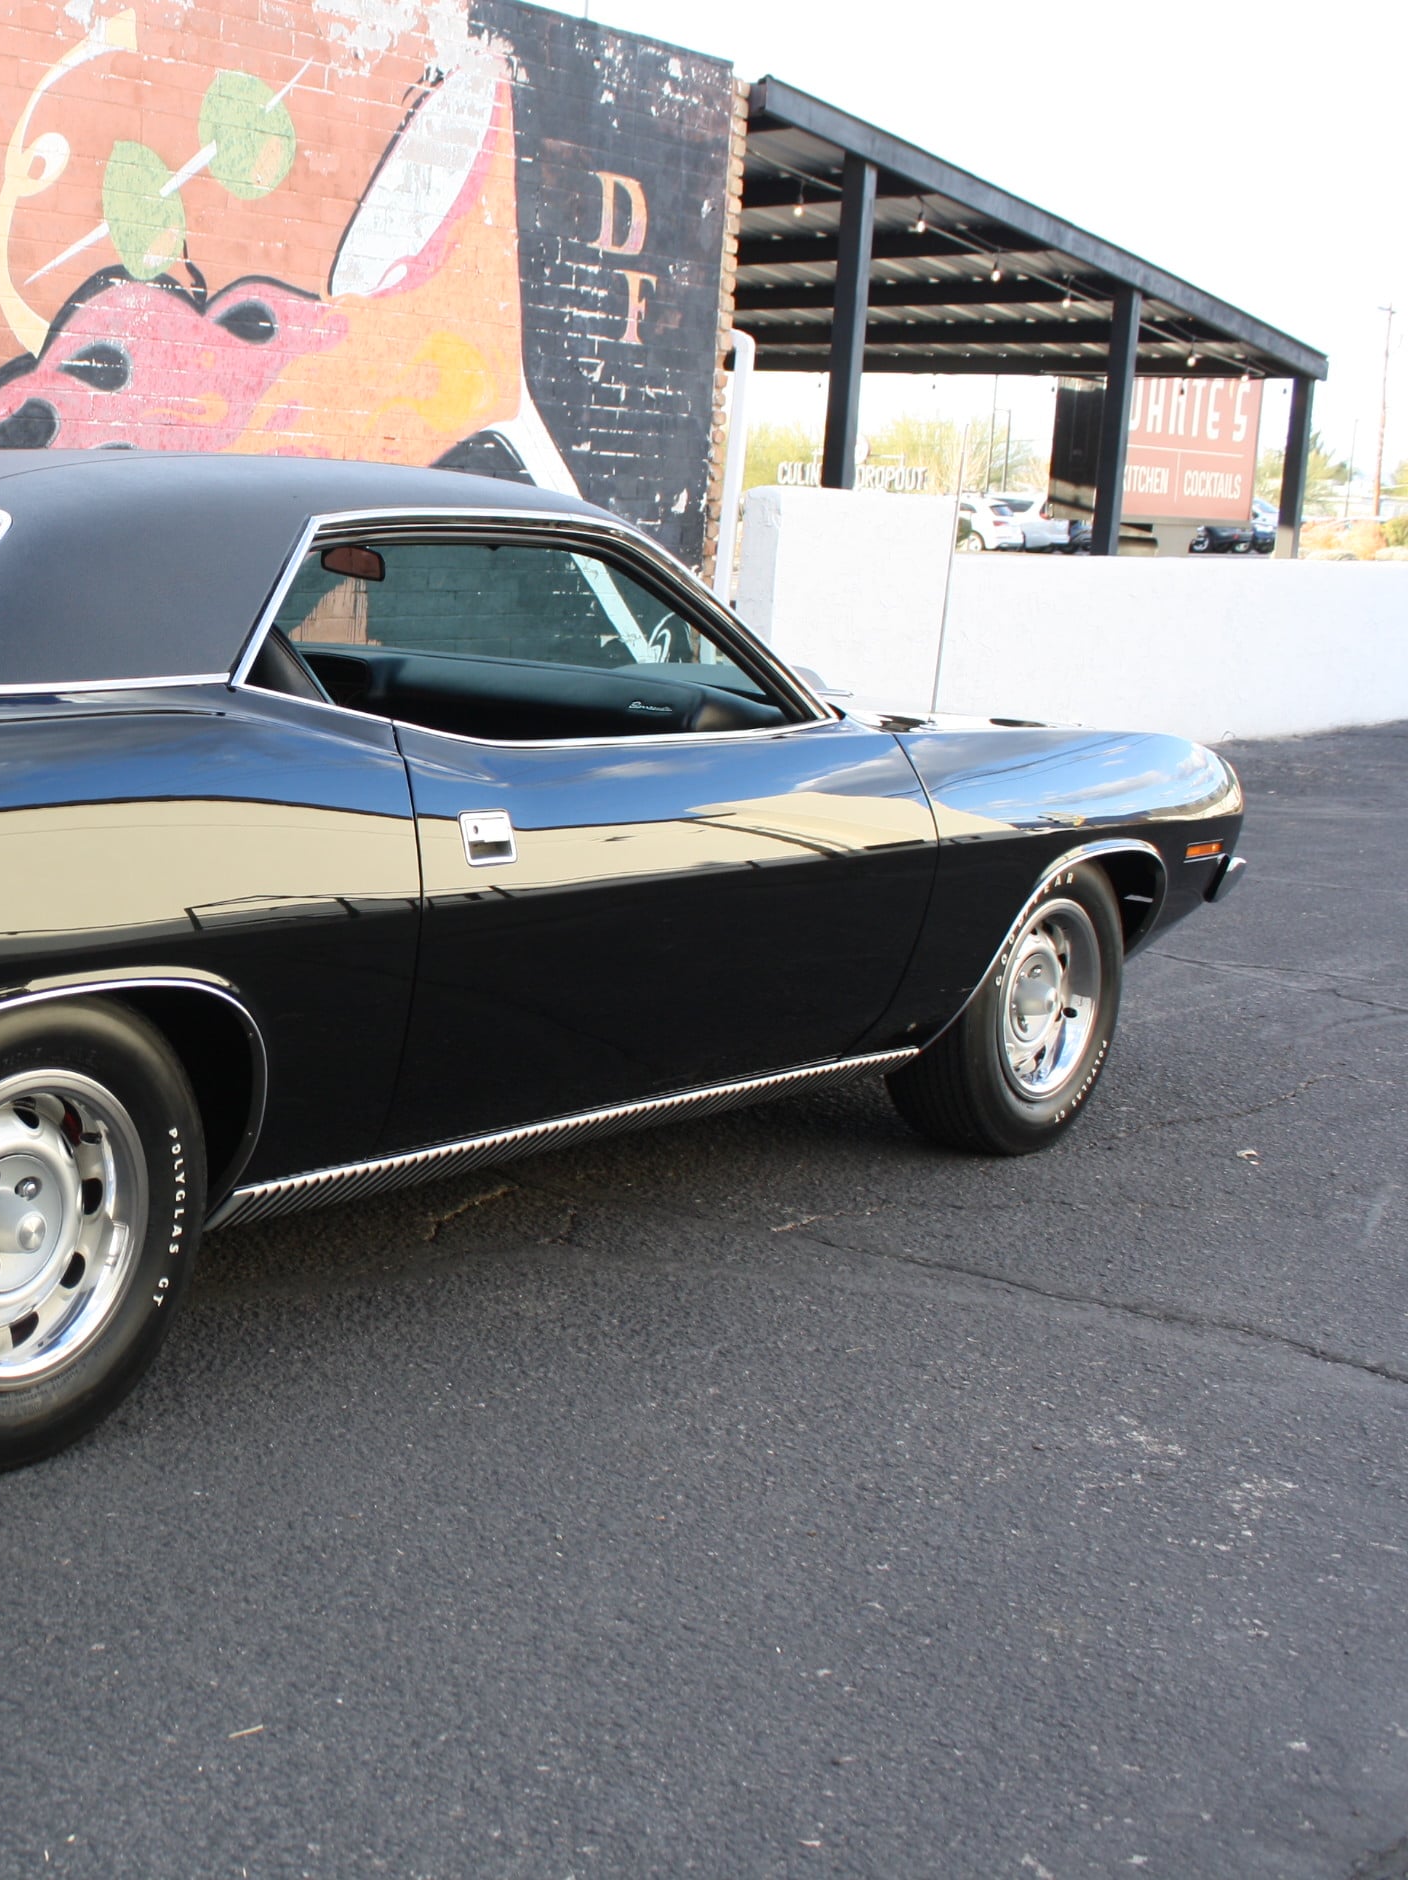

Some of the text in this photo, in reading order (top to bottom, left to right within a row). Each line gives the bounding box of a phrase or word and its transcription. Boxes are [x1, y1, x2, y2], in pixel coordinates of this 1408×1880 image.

[589, 170, 648, 255] D
[615, 270, 658, 345] F
[777, 461, 928, 491] CULIN DROPOUT
[1183, 469, 1242, 500] COCKTAILS
[152, 1127, 186, 1307] POLYGLAS GT
